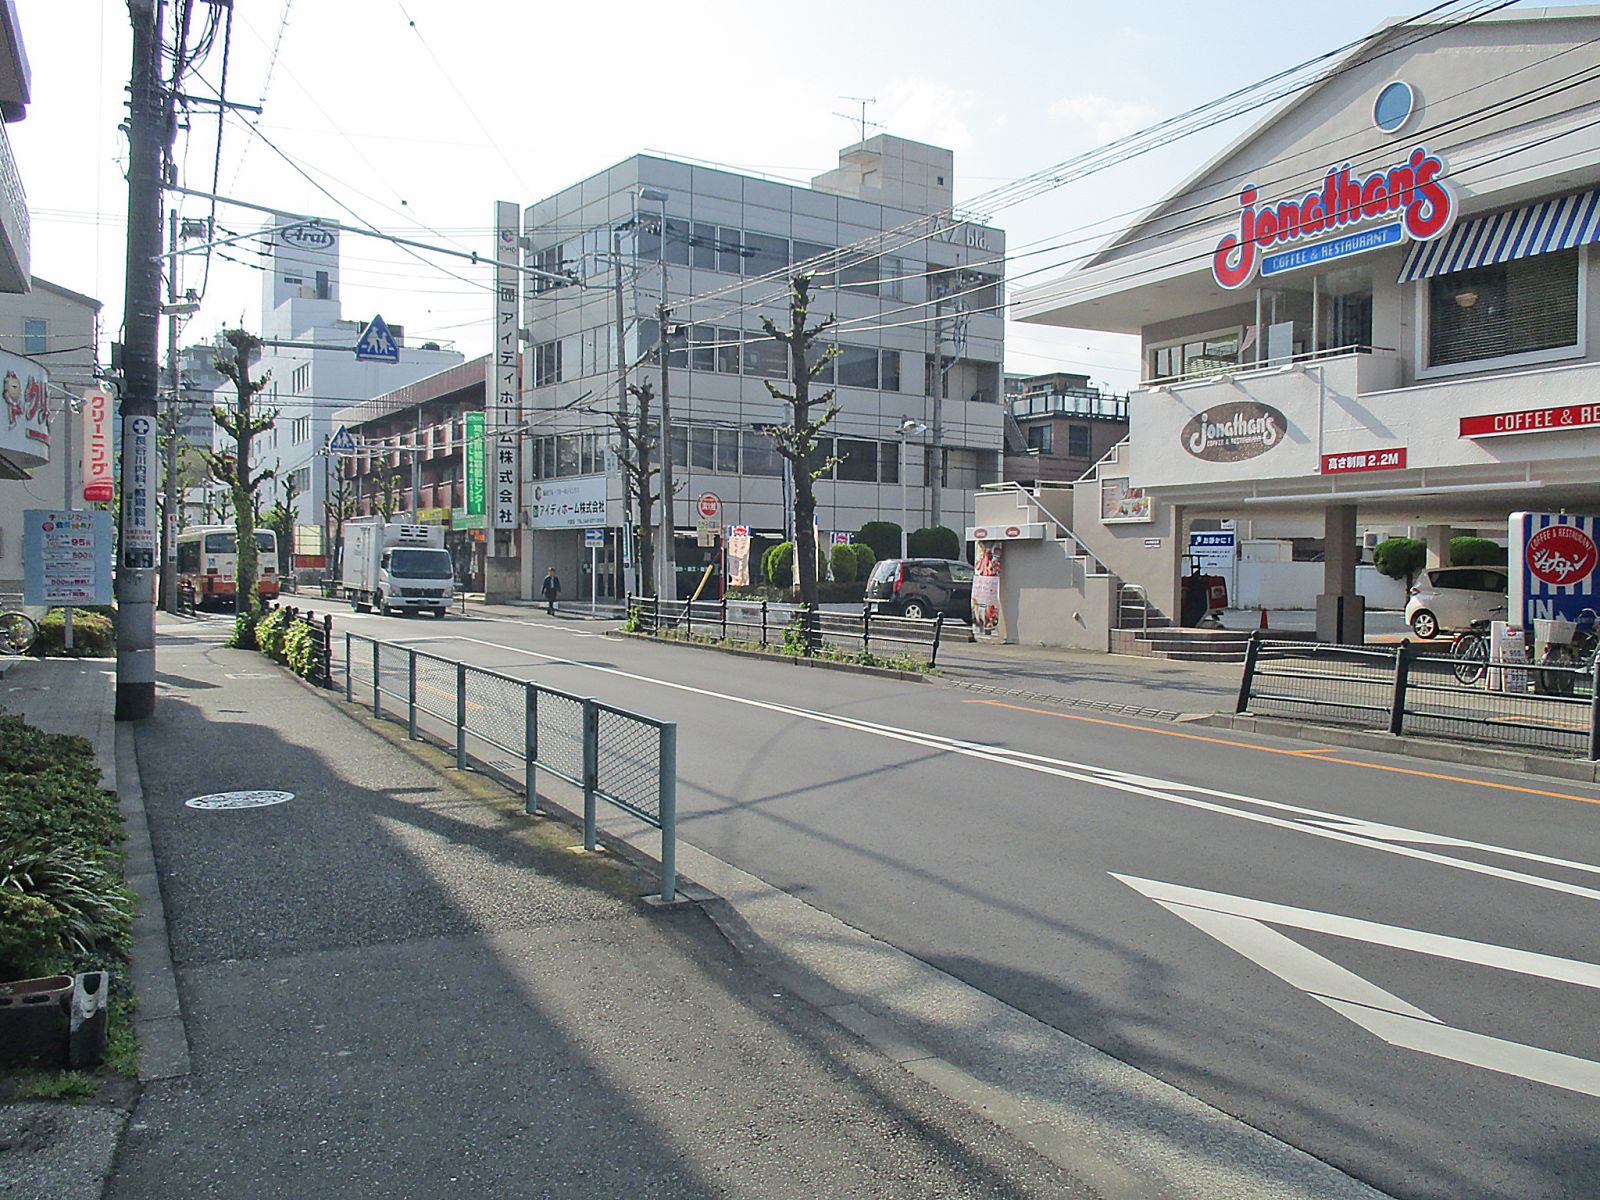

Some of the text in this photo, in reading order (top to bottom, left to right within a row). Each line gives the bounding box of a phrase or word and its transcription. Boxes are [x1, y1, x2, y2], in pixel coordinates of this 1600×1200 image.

[1272, 231, 1388, 270] COFFEE & RESTAURANT
[1494, 406, 1600, 431] COFFEE & RE
[91, 396, 109, 476] クリーニング
[1367, 452, 1399, 467] 2.2M
[539, 500, 605, 518] アイディホーム株式会社
[1530, 527, 1593, 551] COFFEE & RESTAURANT
[1532, 547, 1589, 582] ジョナサン
[1528, 599, 1555, 625] IN
